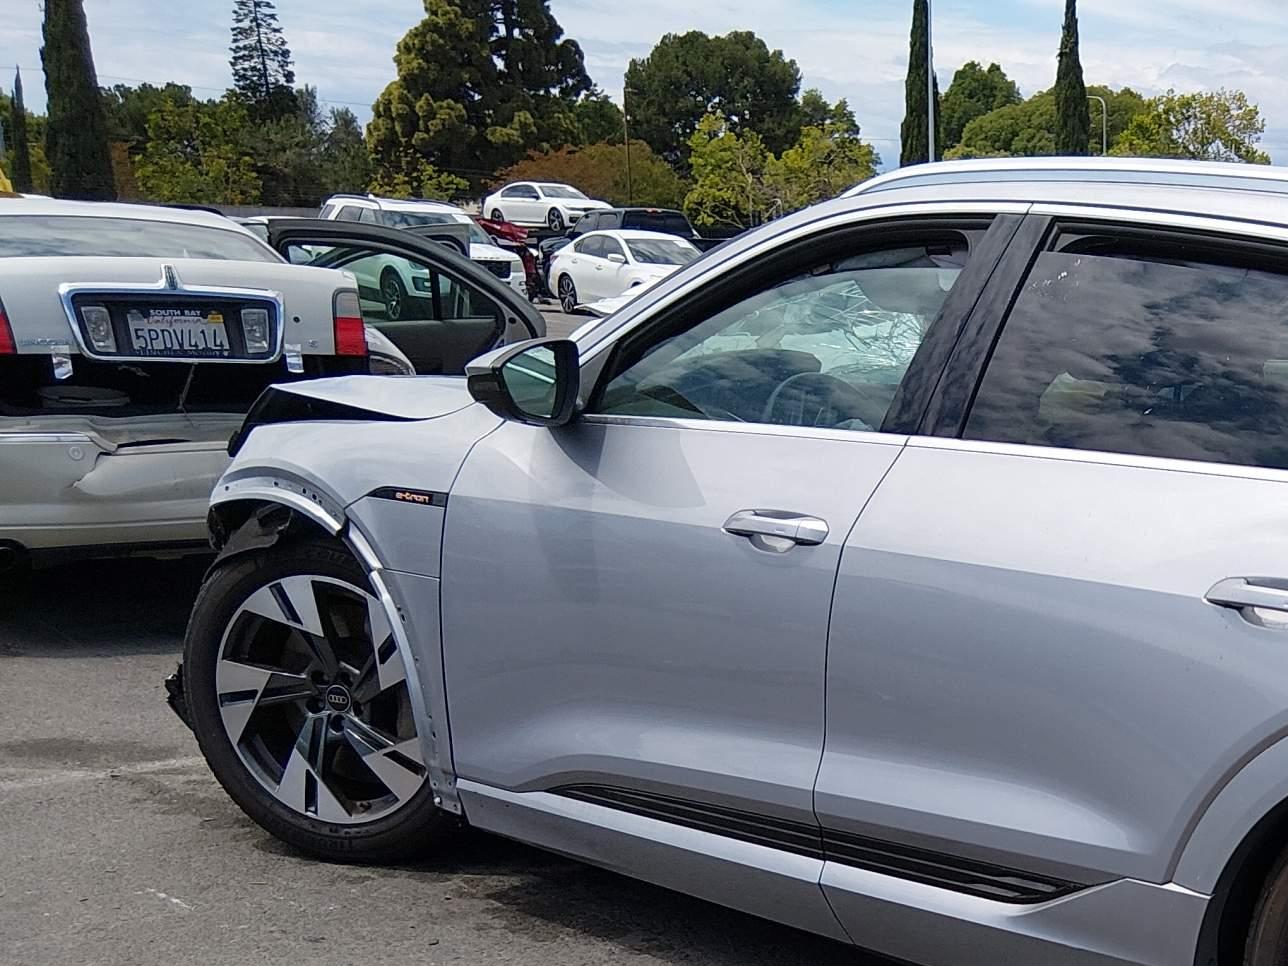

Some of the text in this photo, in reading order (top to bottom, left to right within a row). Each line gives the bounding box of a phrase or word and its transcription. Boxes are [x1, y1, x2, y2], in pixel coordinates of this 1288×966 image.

[149, 309, 181, 317] SOUTH
[184, 309, 202, 317] BAY
[133, 327, 225, 351] 5PDV414
[395, 491, 430, 504] e-tron
